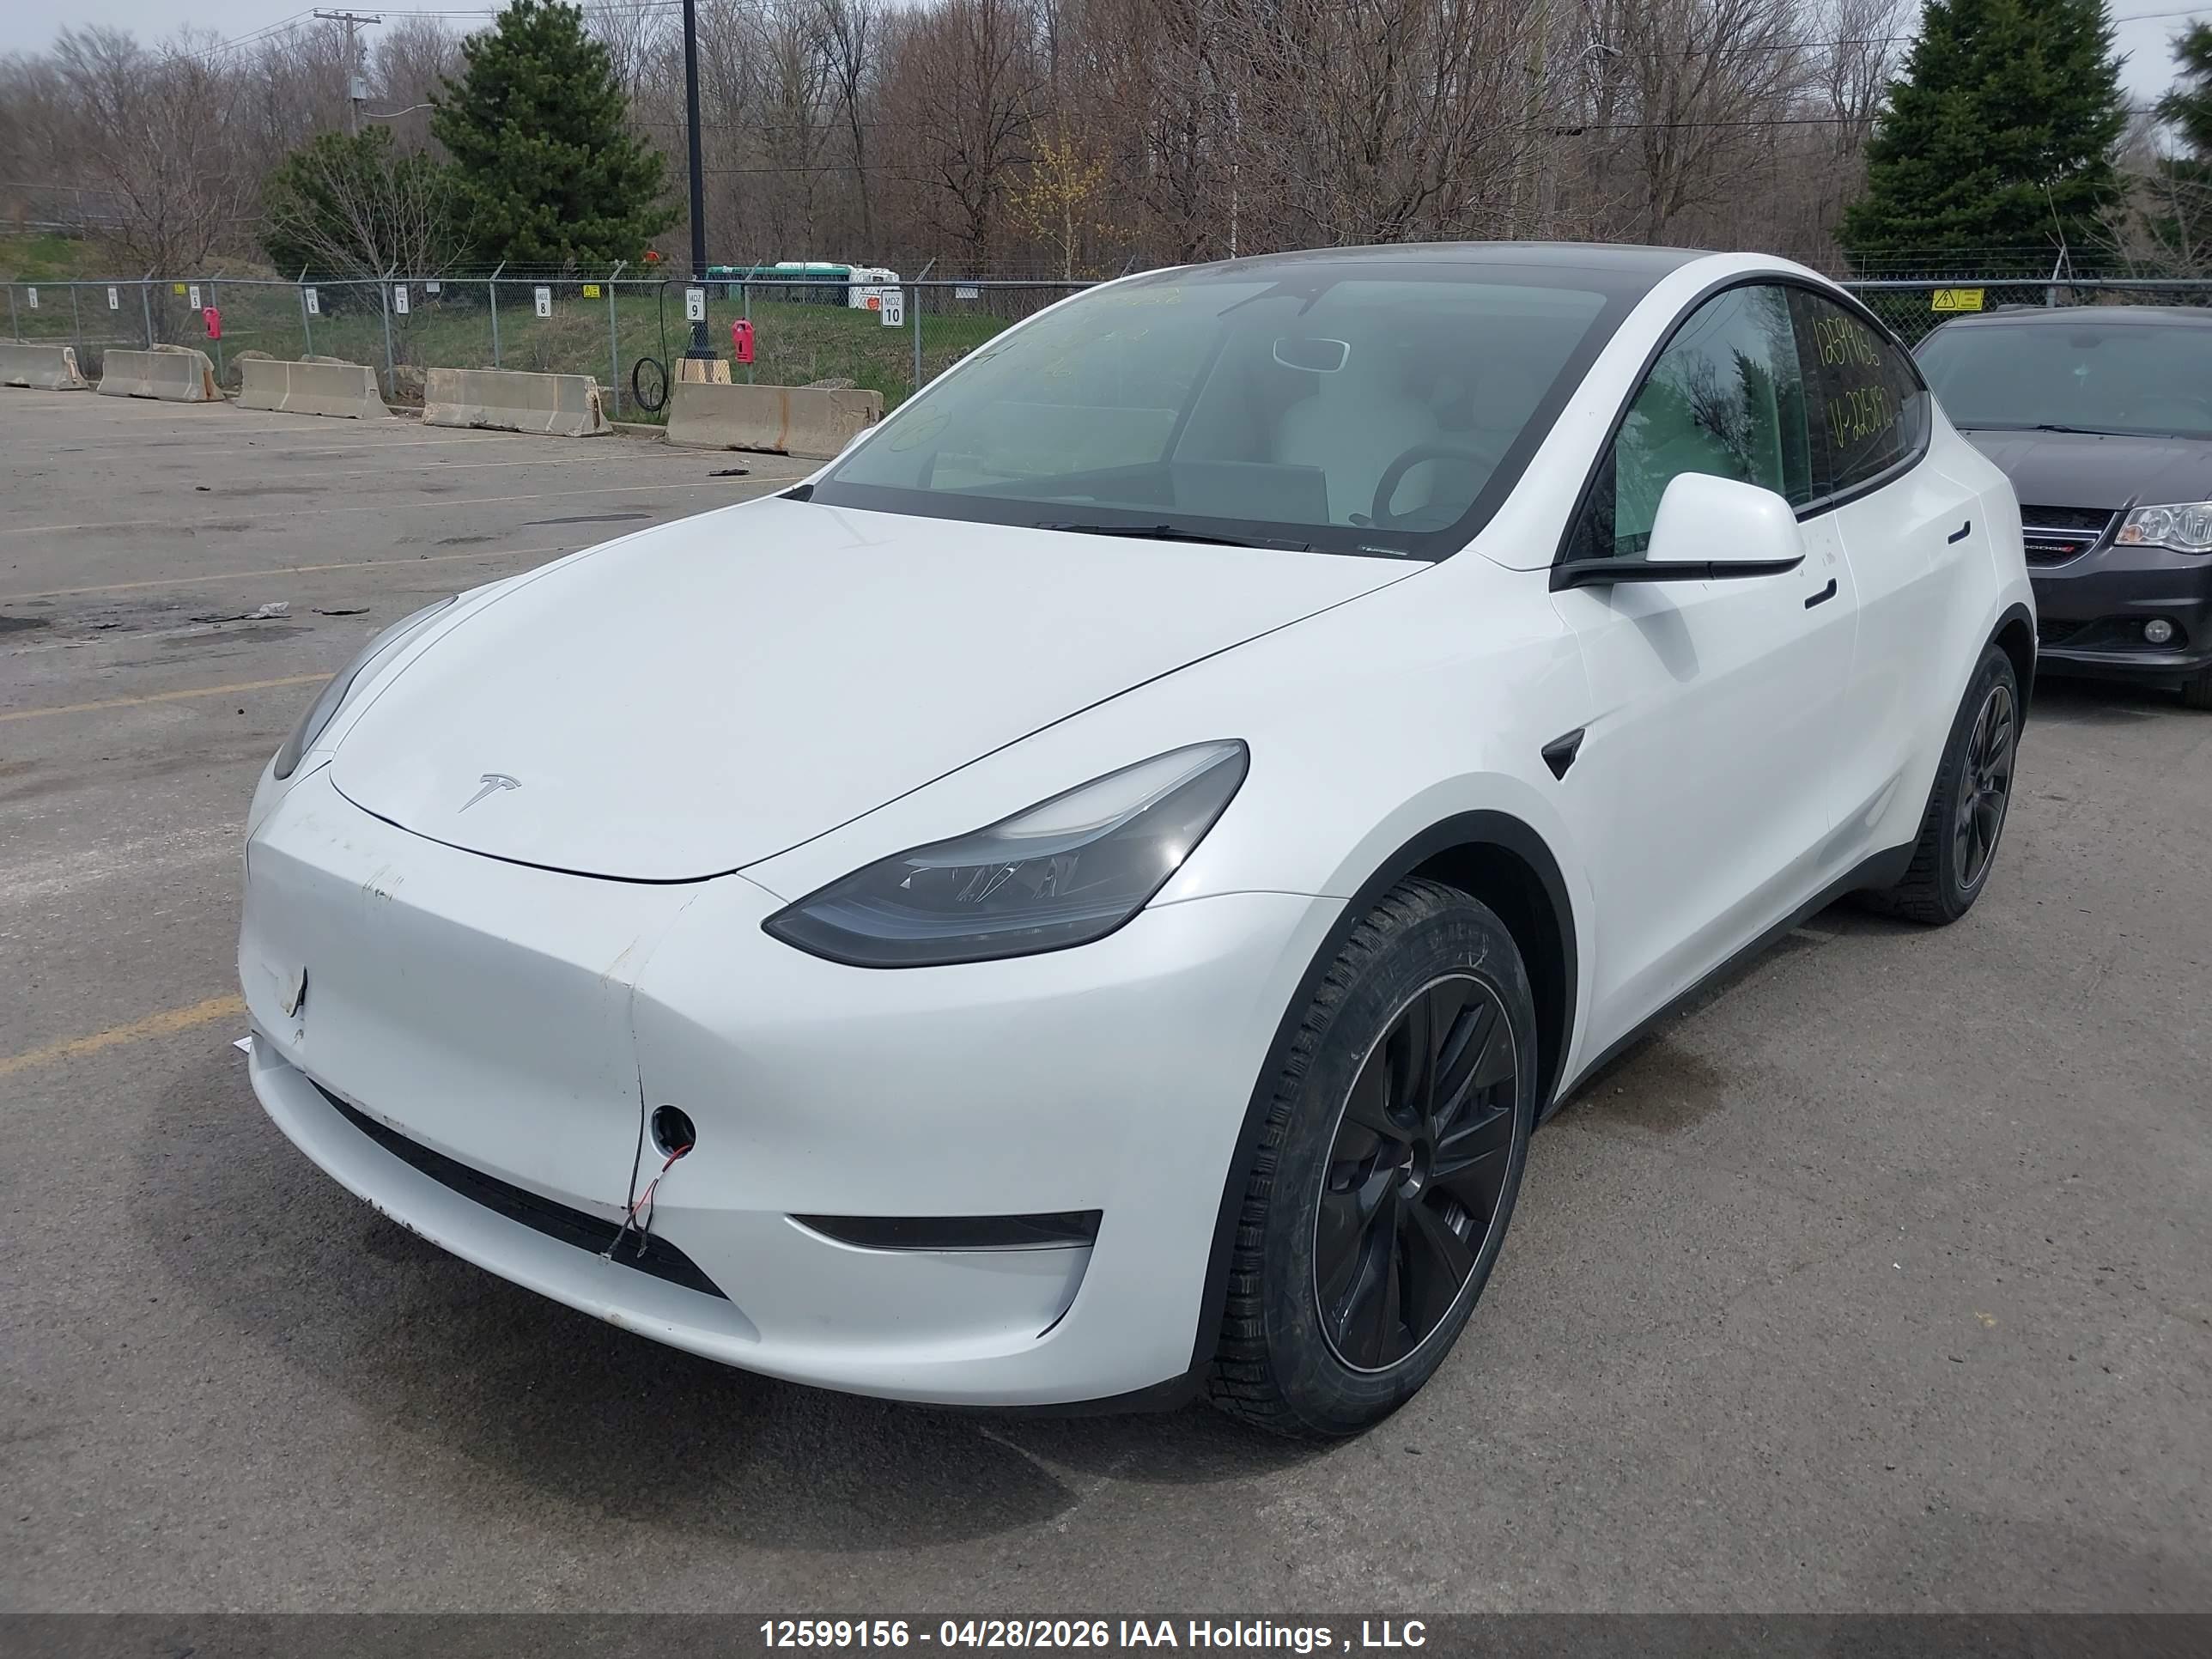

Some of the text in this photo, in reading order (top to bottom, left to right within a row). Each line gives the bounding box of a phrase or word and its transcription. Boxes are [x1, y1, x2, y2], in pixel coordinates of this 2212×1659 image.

[311, 301, 315, 311] 6
[399, 301, 404, 310] 7
[884, 297, 900, 306] MDZ
[540, 303, 546, 314] 8
[691, 305, 698, 317] 9
[885, 308, 900, 322] 10
[1811, 315, 1881, 368] 12599156
